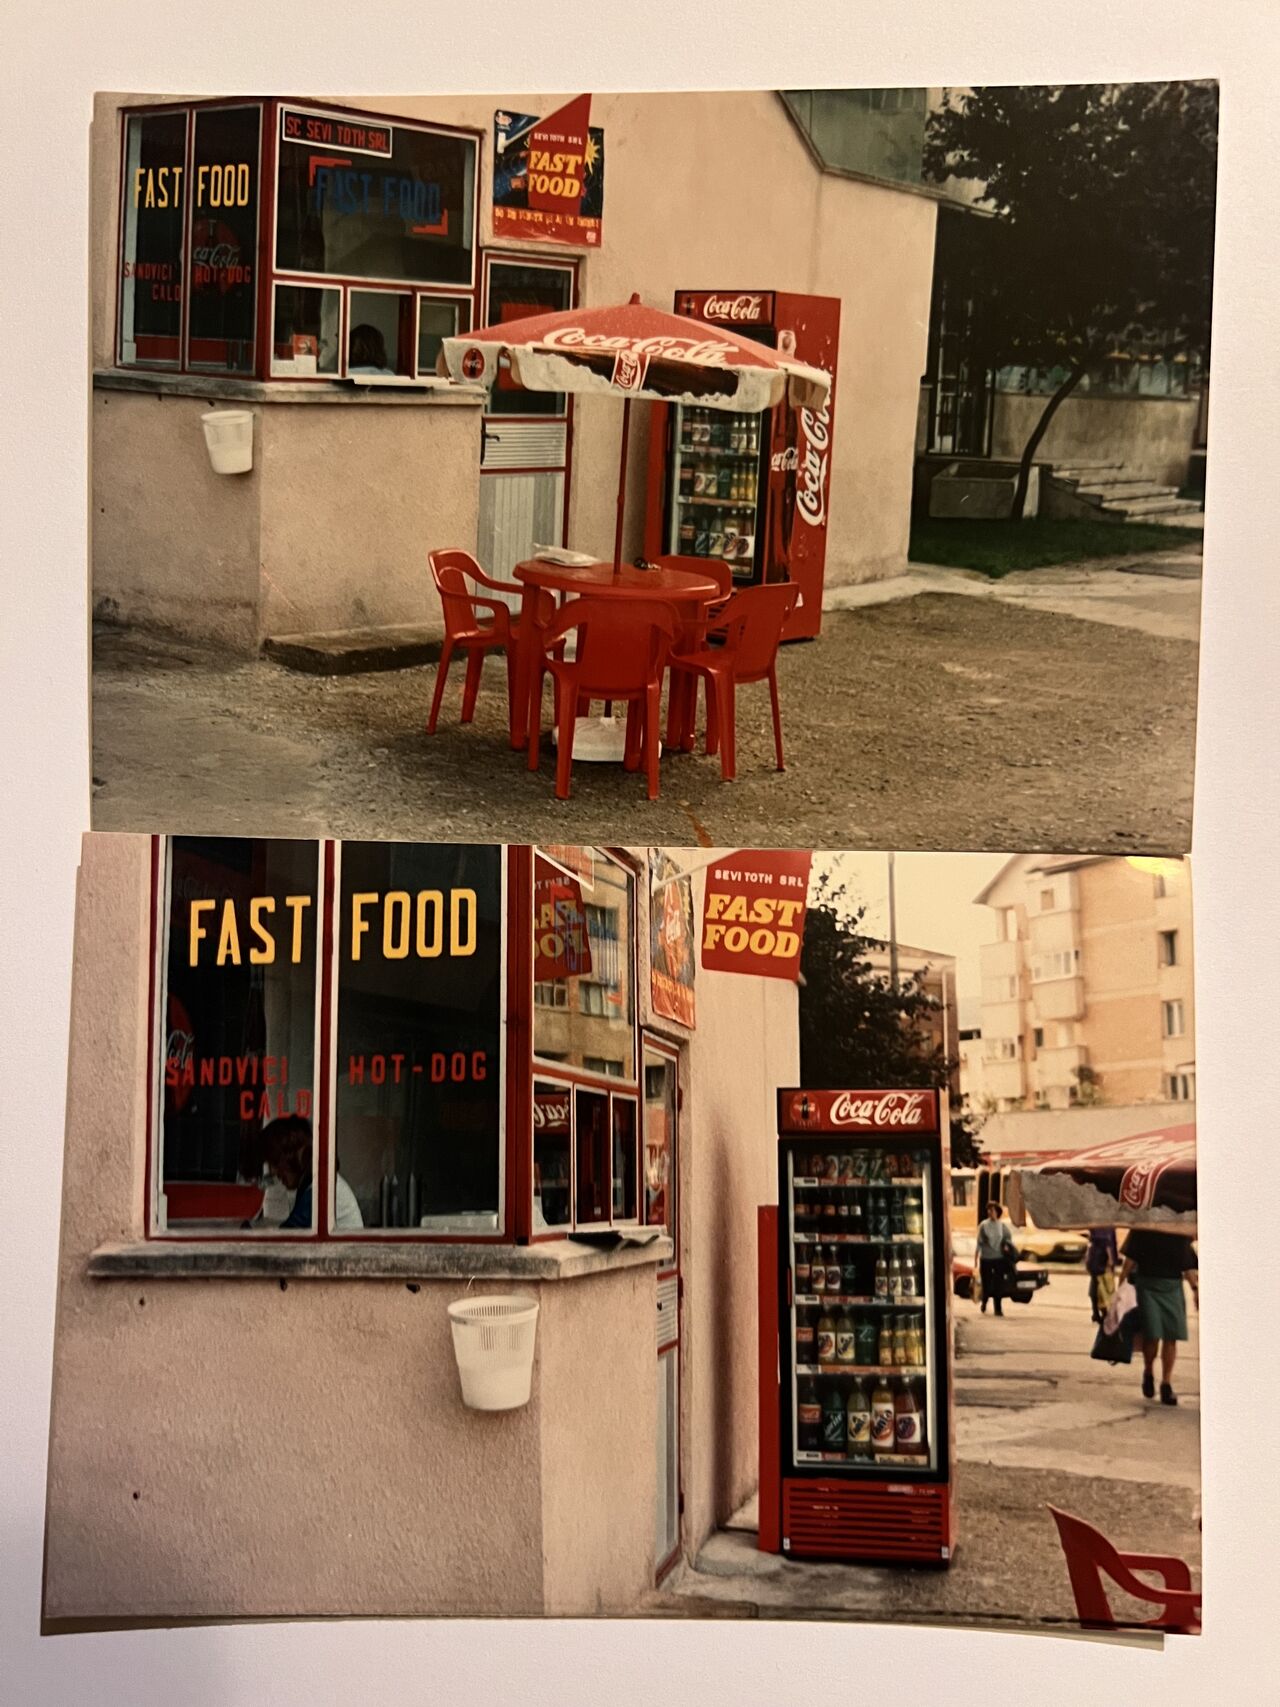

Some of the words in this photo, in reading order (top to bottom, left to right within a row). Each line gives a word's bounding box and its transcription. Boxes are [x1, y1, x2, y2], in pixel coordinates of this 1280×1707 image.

[286, 116, 301, 136] SC
[307, 120, 332, 143] SEVI
[337, 125, 366, 148] TOTH
[368, 131, 389, 150] SRL
[529, 151, 583, 175] FAST
[134, 167, 183, 208] FAST
[198, 164, 249, 207] FOOD
[528, 173, 580, 198] FOOD
[703, 296, 762, 320] Coca-Cola
[543, 328, 739, 366] Coca-Cola
[715, 869, 741, 881] SEVI
[744, 872, 772, 884] TOTH
[780, 875, 803, 887] SRL
[706, 893, 803, 927] FAST
[189, 895, 311, 967] FAST
[351, 888, 477, 961] FOOD
[703, 924, 800, 958] FOOD
[166, 1055, 288, 1087] SANDVICI
[349, 1052, 487, 1086] HOT-DOG
[830, 1093, 925, 1125] Coca-Cola
